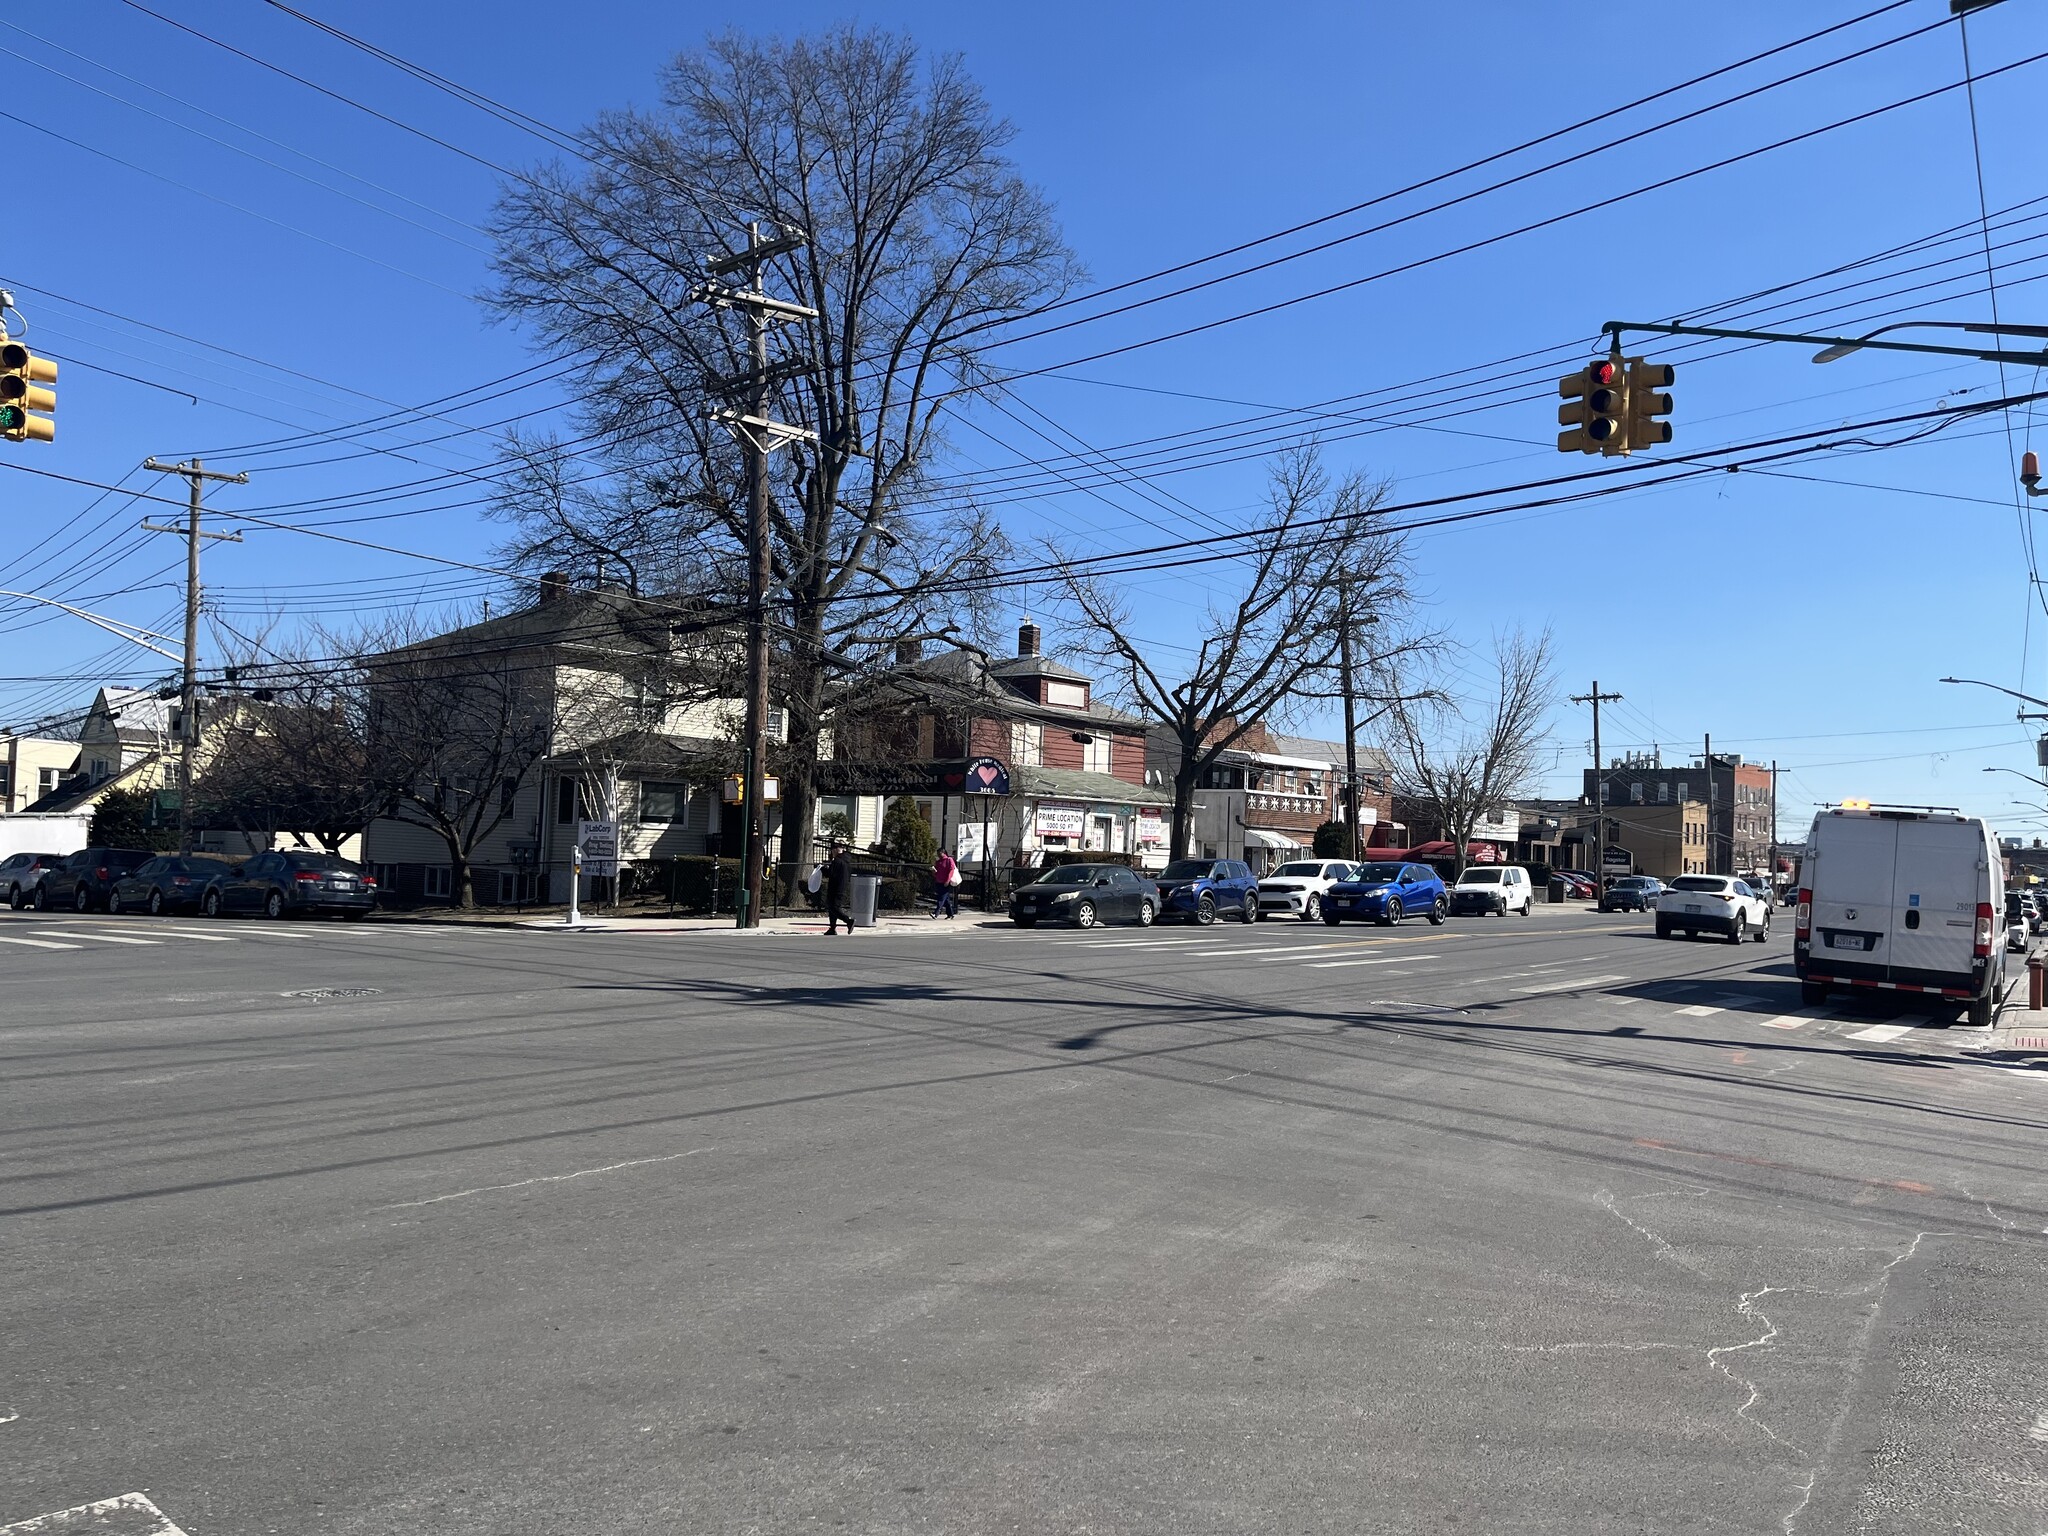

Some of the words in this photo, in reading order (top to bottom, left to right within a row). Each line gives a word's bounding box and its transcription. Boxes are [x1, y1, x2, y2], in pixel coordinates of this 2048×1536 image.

[1038, 813, 1056, 821] PRIME
[1056, 814, 1083, 823] LOCATION
[589, 824, 611, 833] LabCorp
